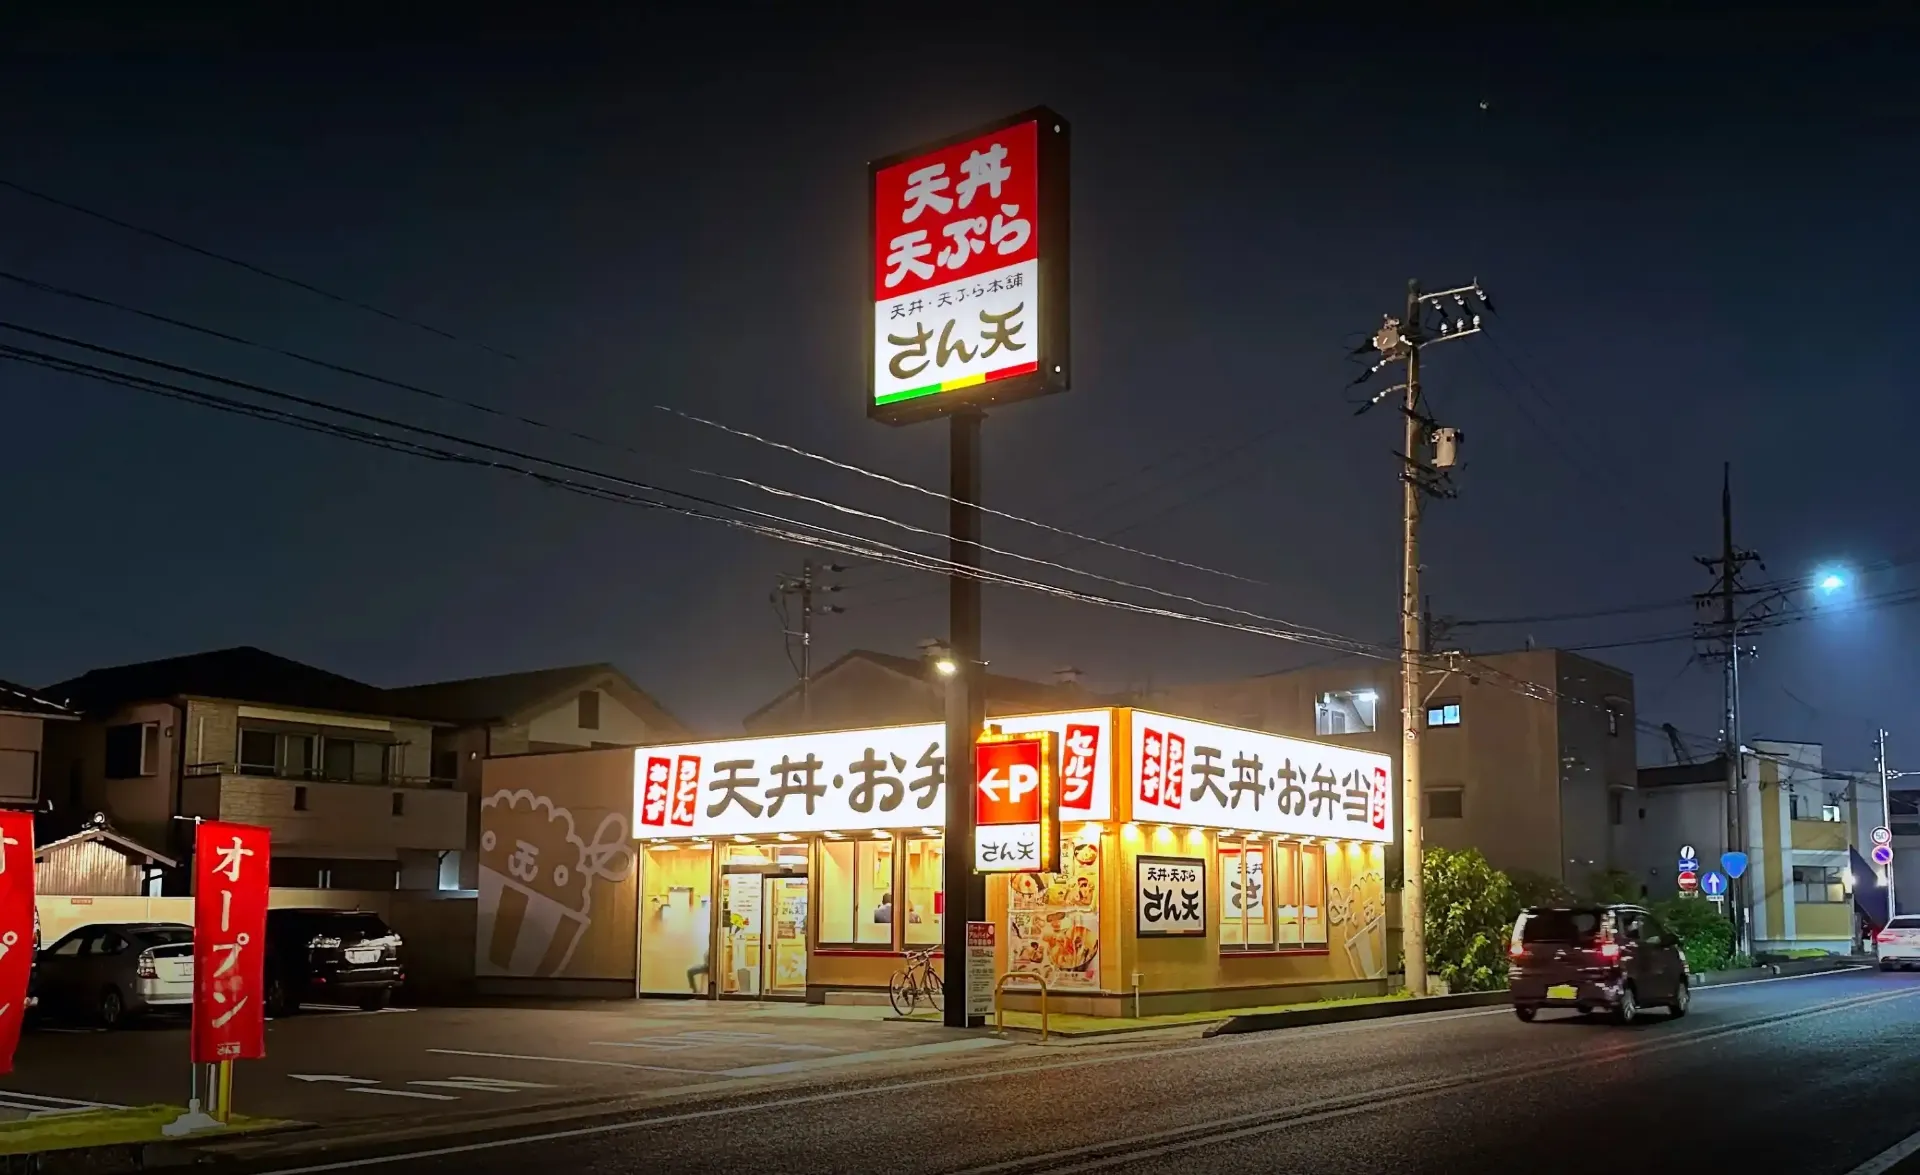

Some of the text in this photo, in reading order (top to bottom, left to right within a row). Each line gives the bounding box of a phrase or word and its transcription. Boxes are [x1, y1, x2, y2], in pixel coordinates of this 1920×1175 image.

[902, 143, 1012, 223] 天丼
[884, 204, 1031, 288] 天ぷら
[887, 301, 1026, 379] さん天
[672, 760, 697, 822] うどん
[1009, 764, 1039, 803] P
[1063, 730, 1095, 801] セルフ
[1165, 738, 1183, 804] うどん
[1190, 746, 1371, 823] 天丼・お弁当
[982, 841, 1034, 862] さん天
[211, 836, 254, 1029] オープン
[1143, 885, 1200, 923] さん天
